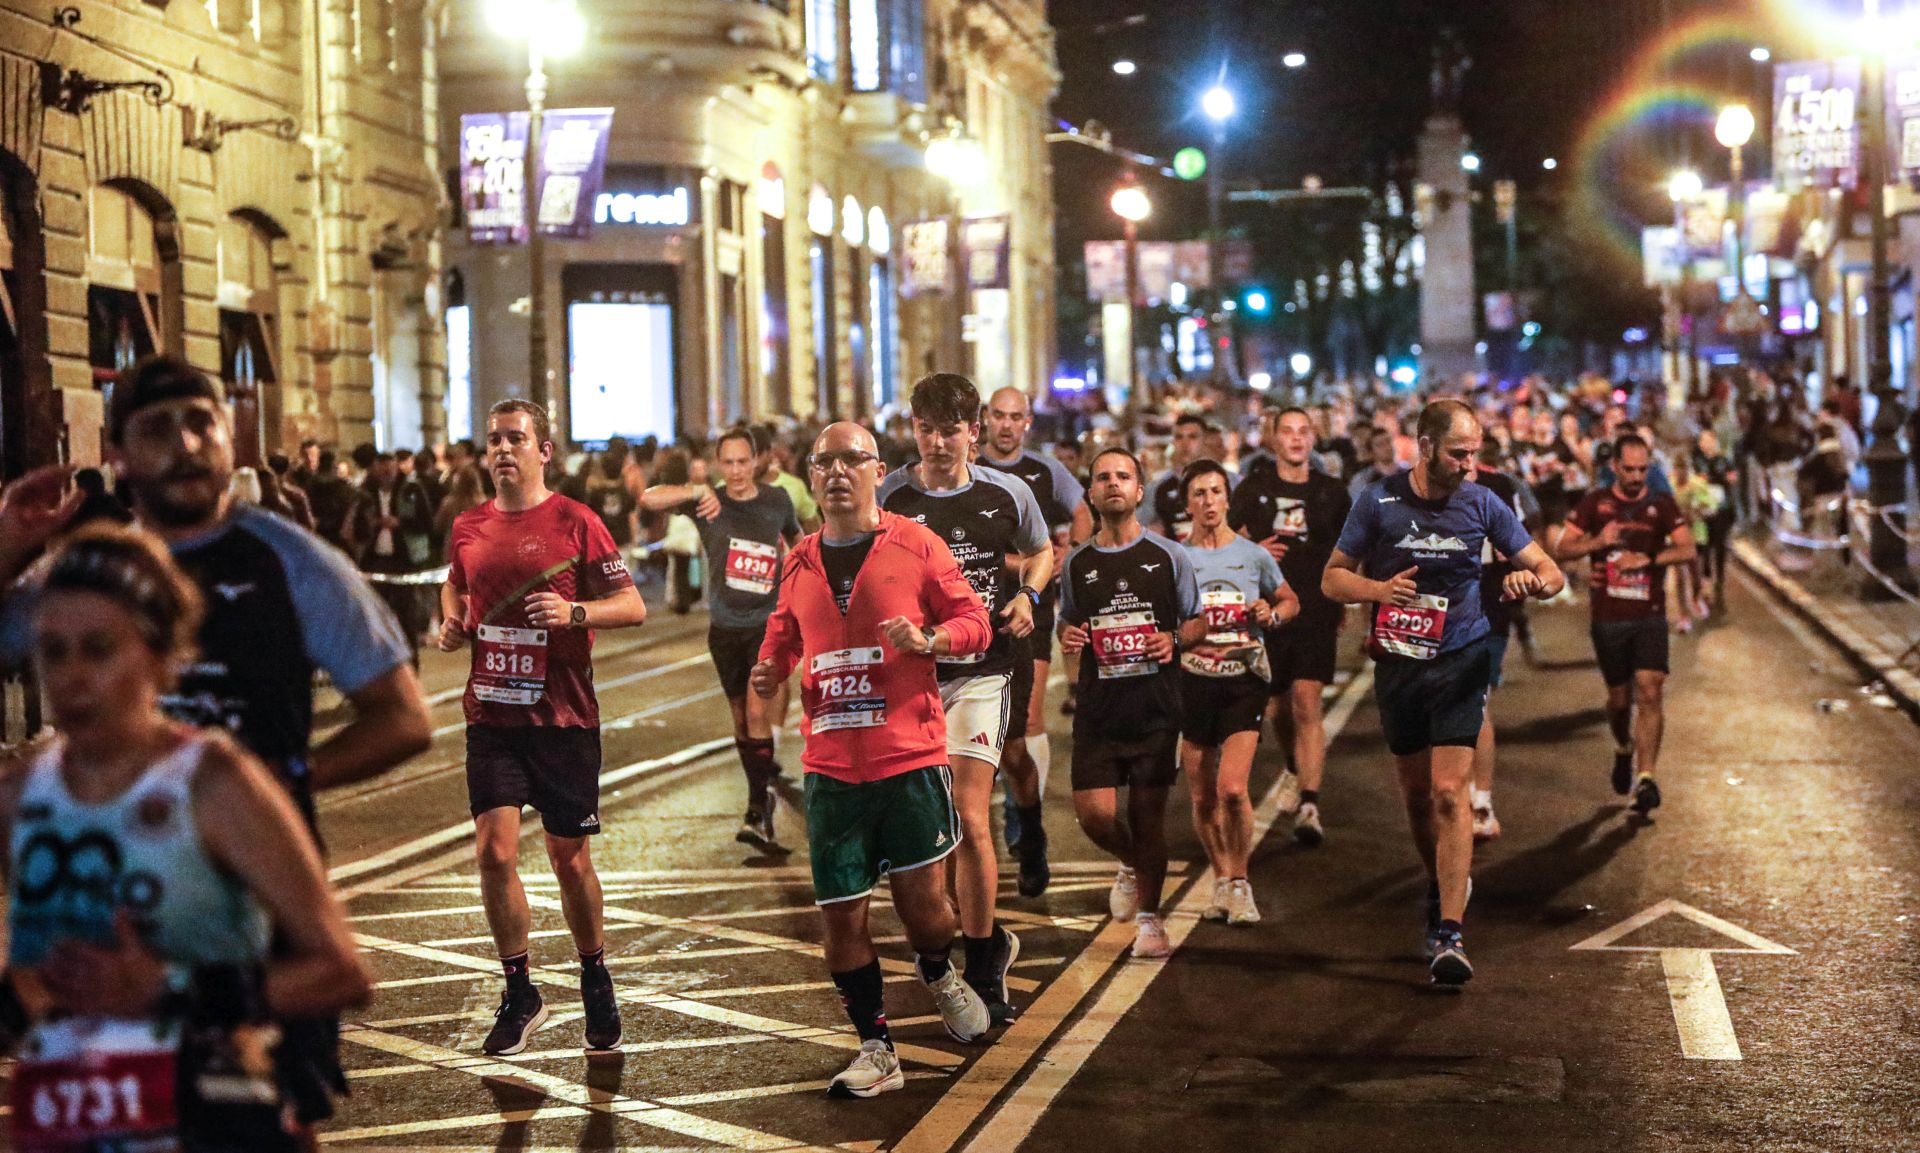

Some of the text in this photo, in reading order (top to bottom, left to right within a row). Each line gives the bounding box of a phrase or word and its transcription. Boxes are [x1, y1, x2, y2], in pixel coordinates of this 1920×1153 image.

[950, 546, 977, 556] ILBAO
[734, 556, 769, 575] 6938
[1110, 596, 1139, 606] BILBAO
[1102, 633, 1146, 653] 8632
[486, 651, 533, 673] 8318
[818, 674, 872, 699] 7826
[32, 1074, 142, 1128] 6731
